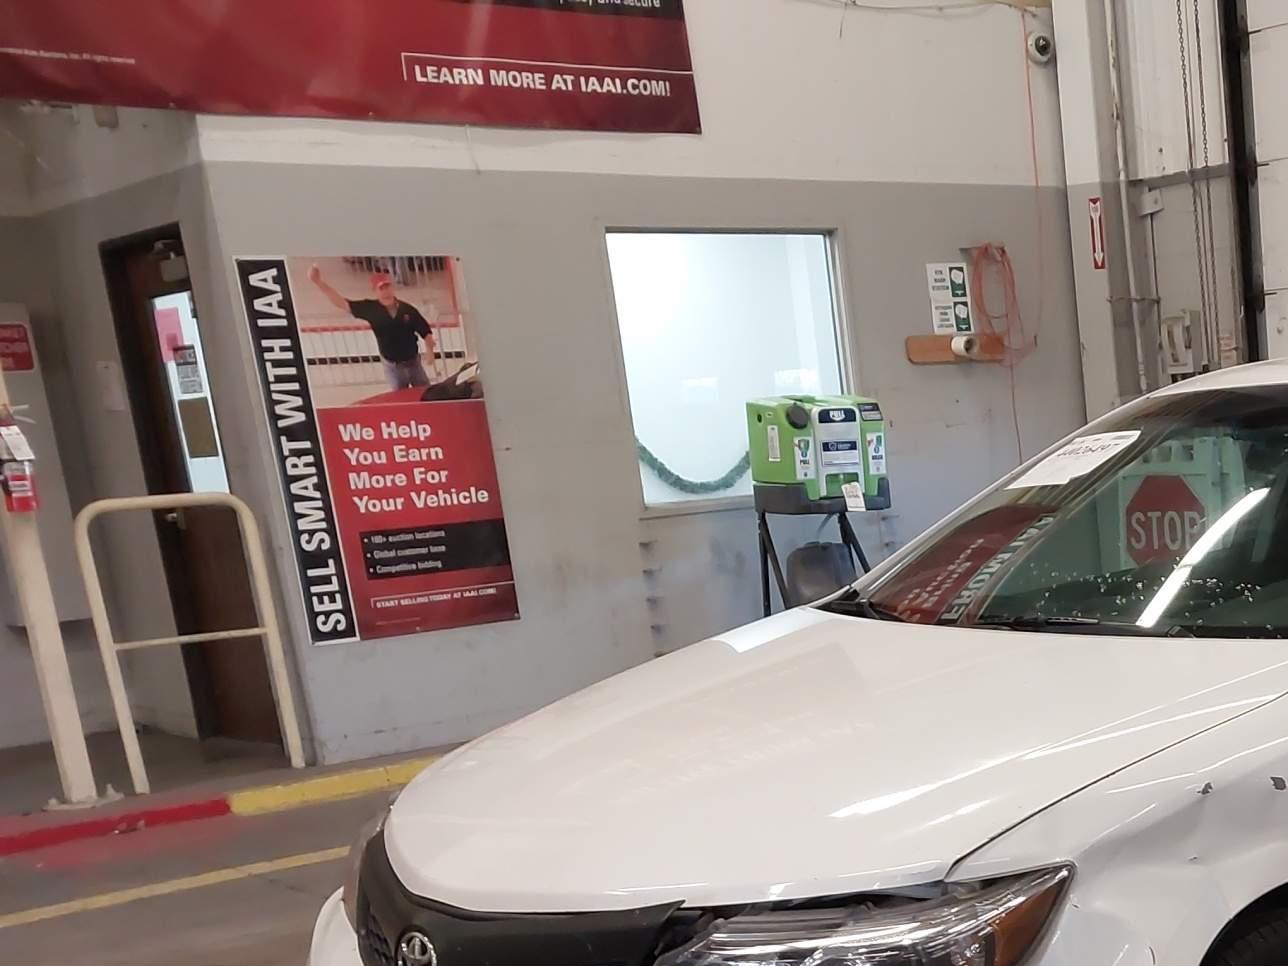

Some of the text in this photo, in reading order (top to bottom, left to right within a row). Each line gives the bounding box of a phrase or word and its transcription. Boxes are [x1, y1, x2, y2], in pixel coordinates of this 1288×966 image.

[415, 65, 671, 96] LEARN MORE AT IAAI.COM!
[338, 420, 432, 442] We Help
[249, 267, 347, 634] SELL SMART WITH IAA
[344, 444, 444, 465] You Earn
[348, 467, 449, 490] More For
[352, 486, 490, 513] Your Vehicle
[1130, 511, 1201, 551] STOP
